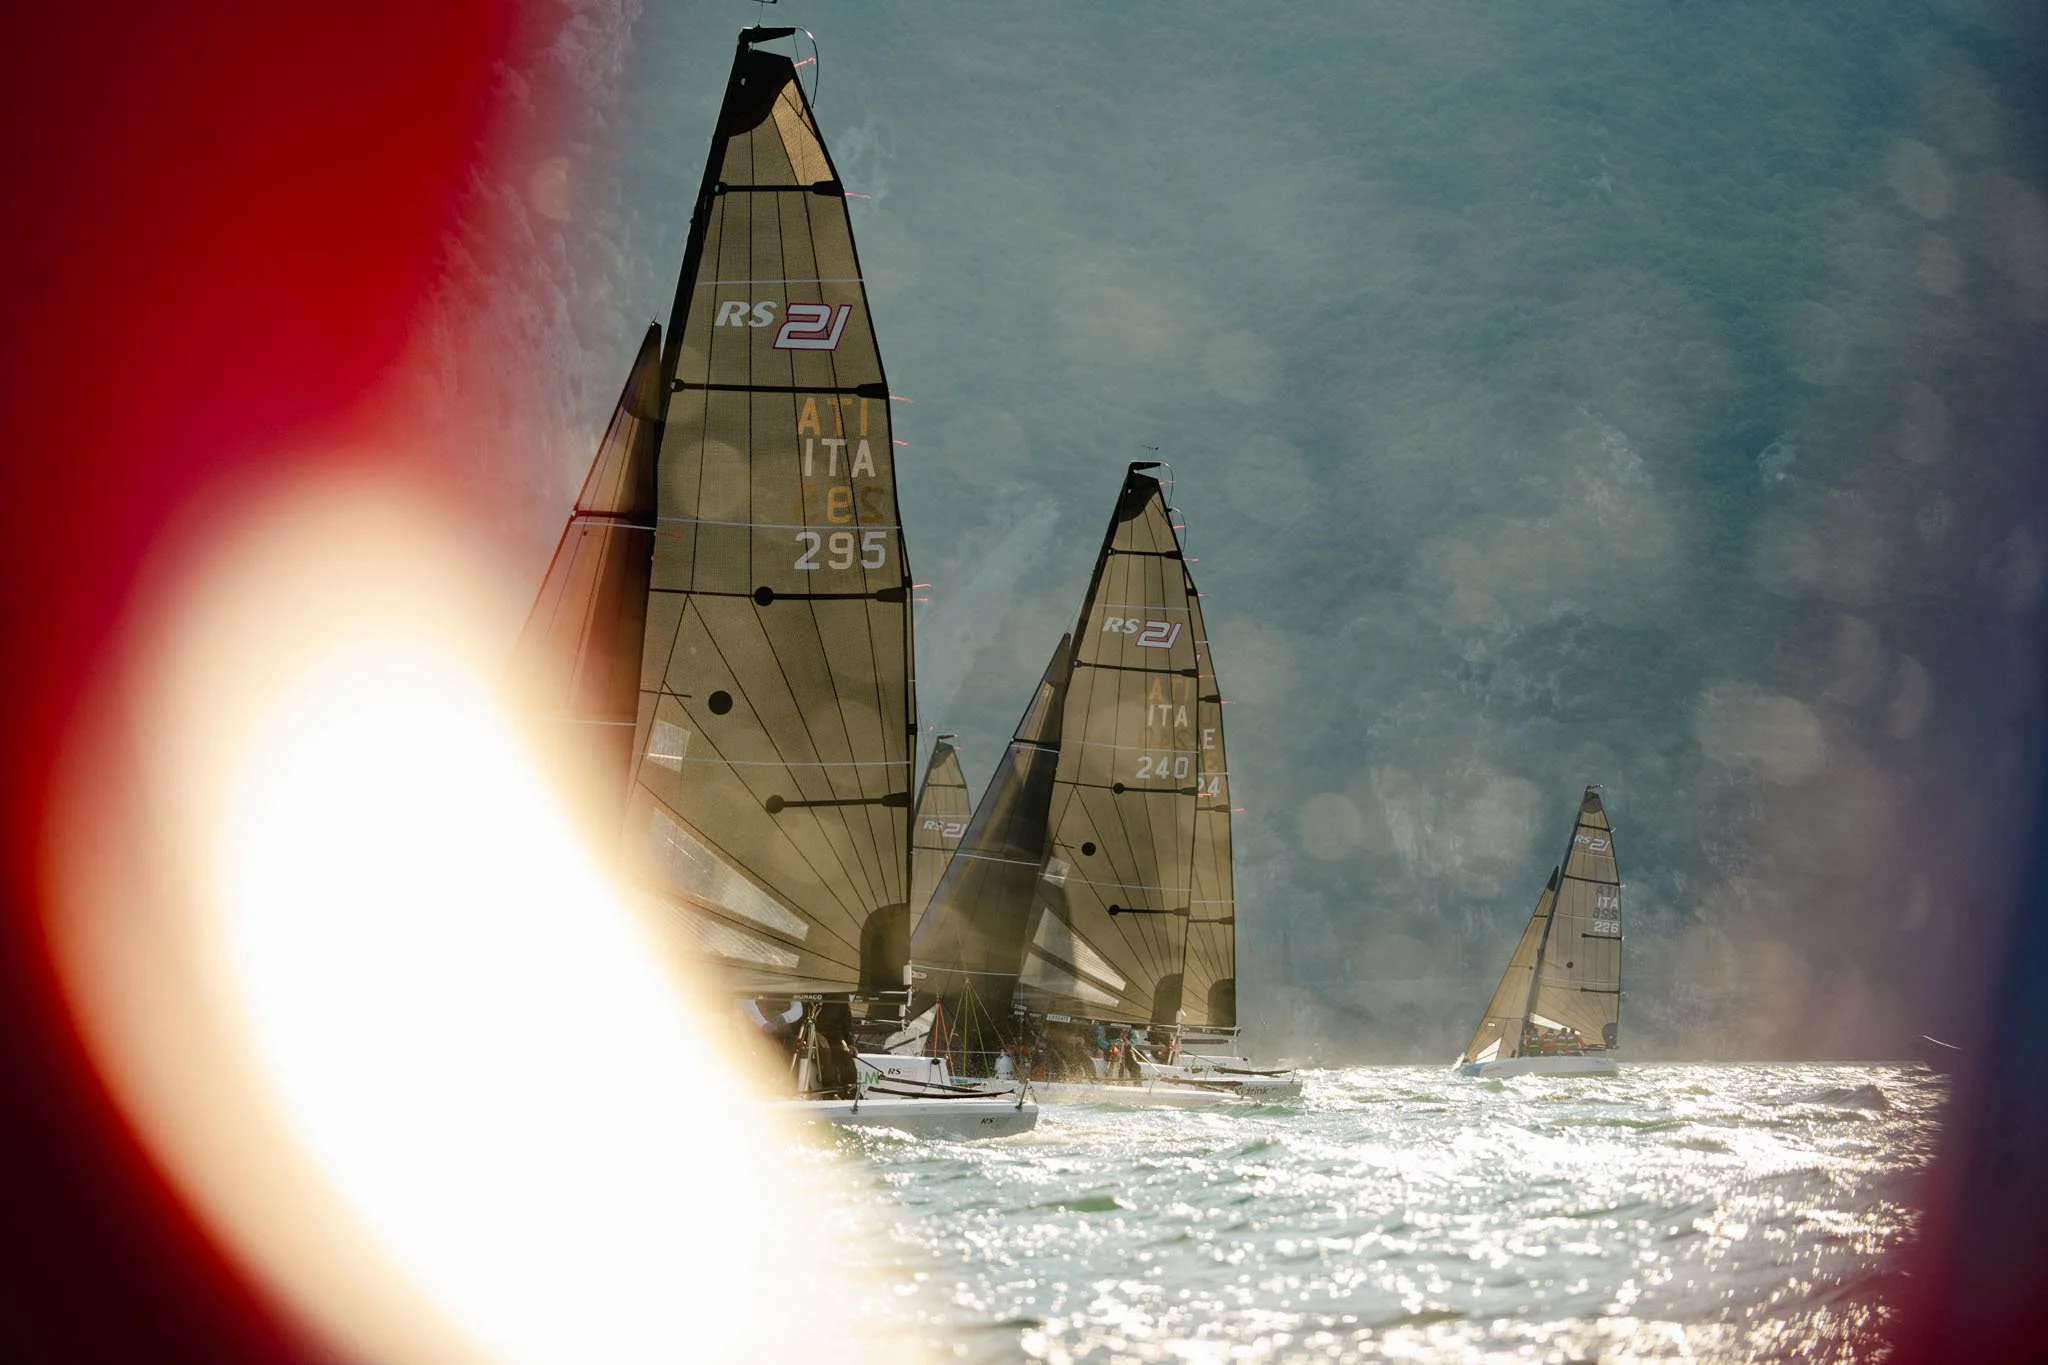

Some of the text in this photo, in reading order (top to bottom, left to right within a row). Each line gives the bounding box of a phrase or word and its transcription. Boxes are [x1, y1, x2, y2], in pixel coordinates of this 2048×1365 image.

[714, 301, 852, 351] RS 21
[804, 438, 876, 478] ITA
[794, 531, 887, 570] 295
[1103, 616, 1183, 649] RS 21
[1148, 704, 1188, 728] ITA
[1135, 756, 1189, 779] 240
[923, 820, 968, 838] RS 21
[1575, 835, 1590, 844] RS
[1597, 896, 1618, 909] ITA
[1594, 921, 1620, 933] 226
[888, 1067, 902, 1075] RS
